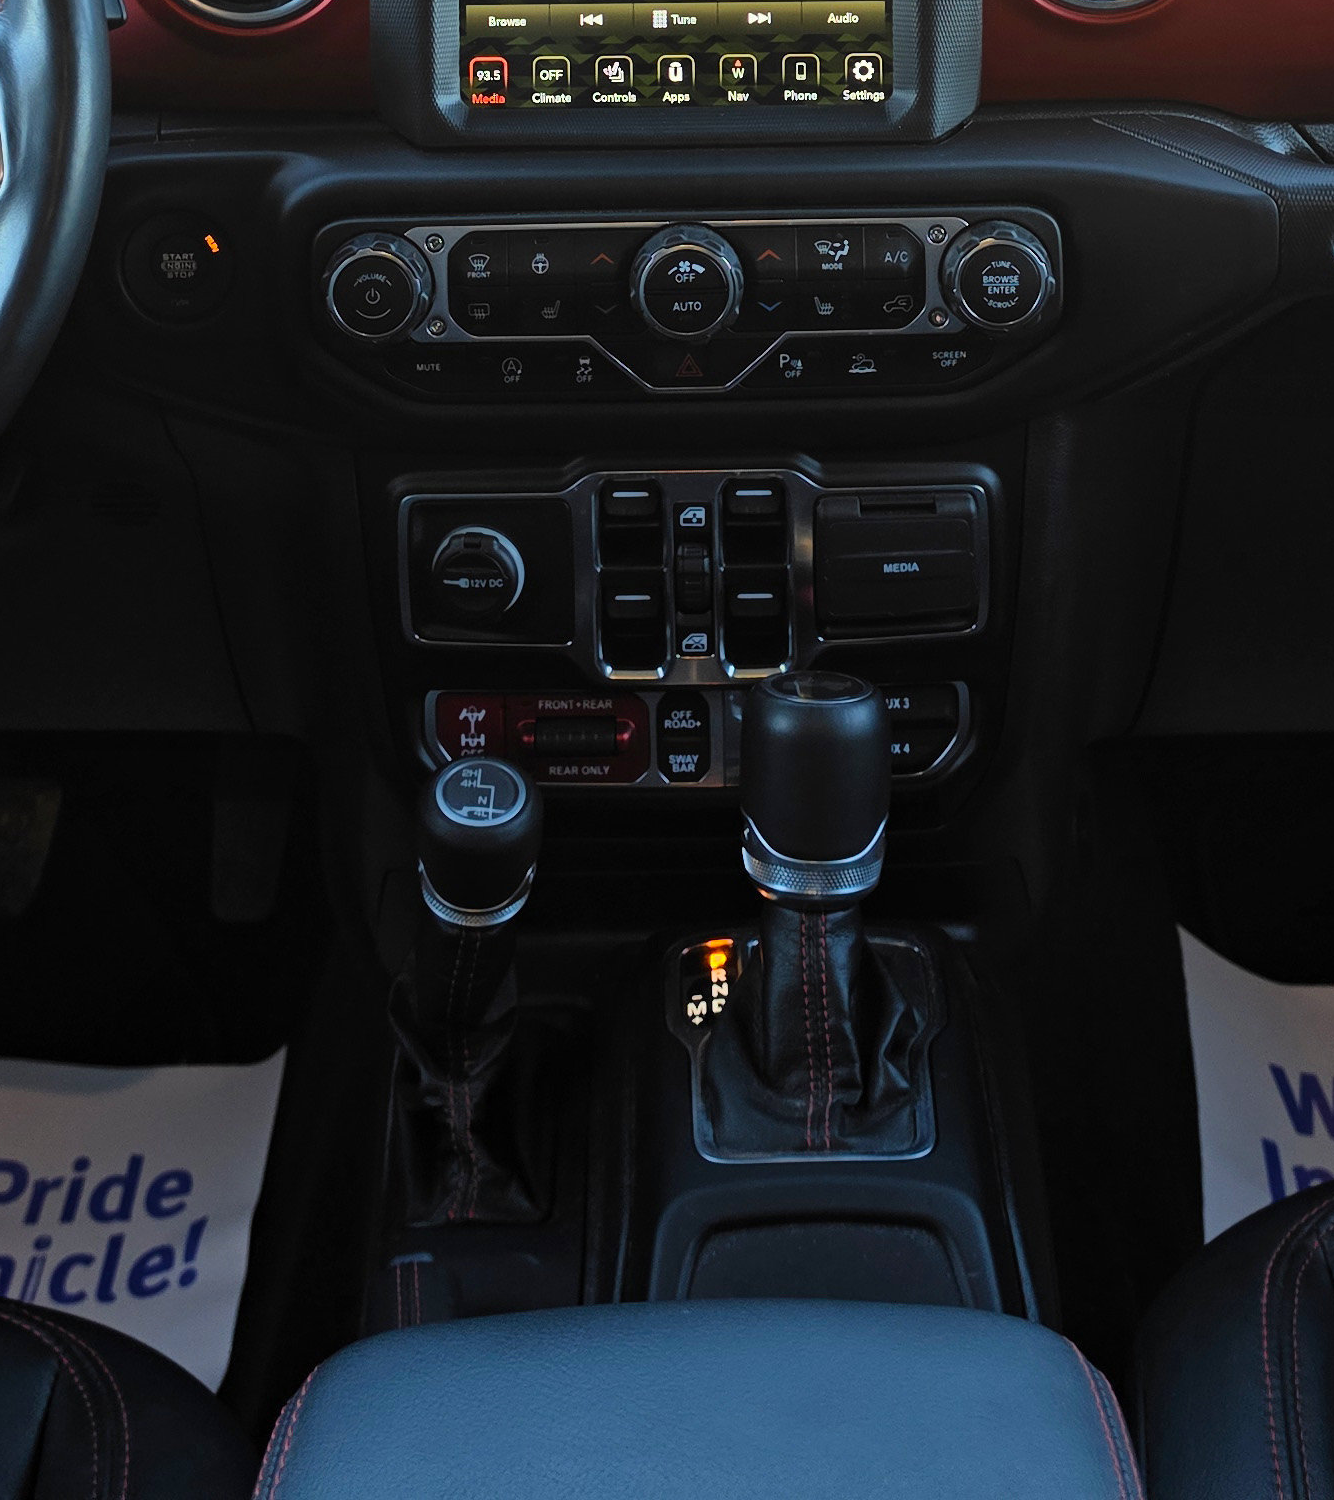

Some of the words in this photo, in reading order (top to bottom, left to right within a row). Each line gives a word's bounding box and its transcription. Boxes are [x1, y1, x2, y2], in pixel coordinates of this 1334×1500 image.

[488, 16, 526, 27] Browse
[670, 13, 697, 25] Tune
[827, 12, 859, 24] Audio
[476, 70, 501, 81] 93.5
[539, 69, 564, 81] OFF
[472, 93, 506, 104] Media
[532, 92, 572, 103] Climate
[592, 92, 637, 103] Controls
[662, 91, 690, 104] Apps
[728, 91, 749, 101] Nav
[784, 90, 818, 101] Phone
[843, 89, 885, 102] Settings
[884, 250, 908, 263] A/C
[991, 260, 1011, 268] TUNE
[357, 274, 387, 285] VOLUME
[467, 271, 491, 279] FRONT
[675, 273, 696, 284] OFF
[982, 275, 1019, 284] BROWSE
[987, 286, 1016, 295] ENTER
[673, 300, 702, 312] AUTO
[987, 299, 1016, 309] SCROLL
[932, 350, 966, 359] SCREEN
[417, 363, 441, 372] MUTE
[940, 359, 957, 368] OFF
[504, 375, 520, 383] OFF
[575, 375, 592, 383] OFF
[785, 370, 801, 378] OFF
[883, 561, 919, 574] MEDIA
[470, 578, 487, 588] 12V
[488, 578, 504, 588] DC
[901, 698, 910, 709] 3
[671, 711, 692, 719] OFF
[902, 743, 910, 754] 4
[668, 755, 699, 764] SWAY
[549, 766, 578, 775] REAR
[581, 765, 610, 775] ONLY
[672, 763, 696, 772] BAR
[687, 1001, 707, 1017] M
